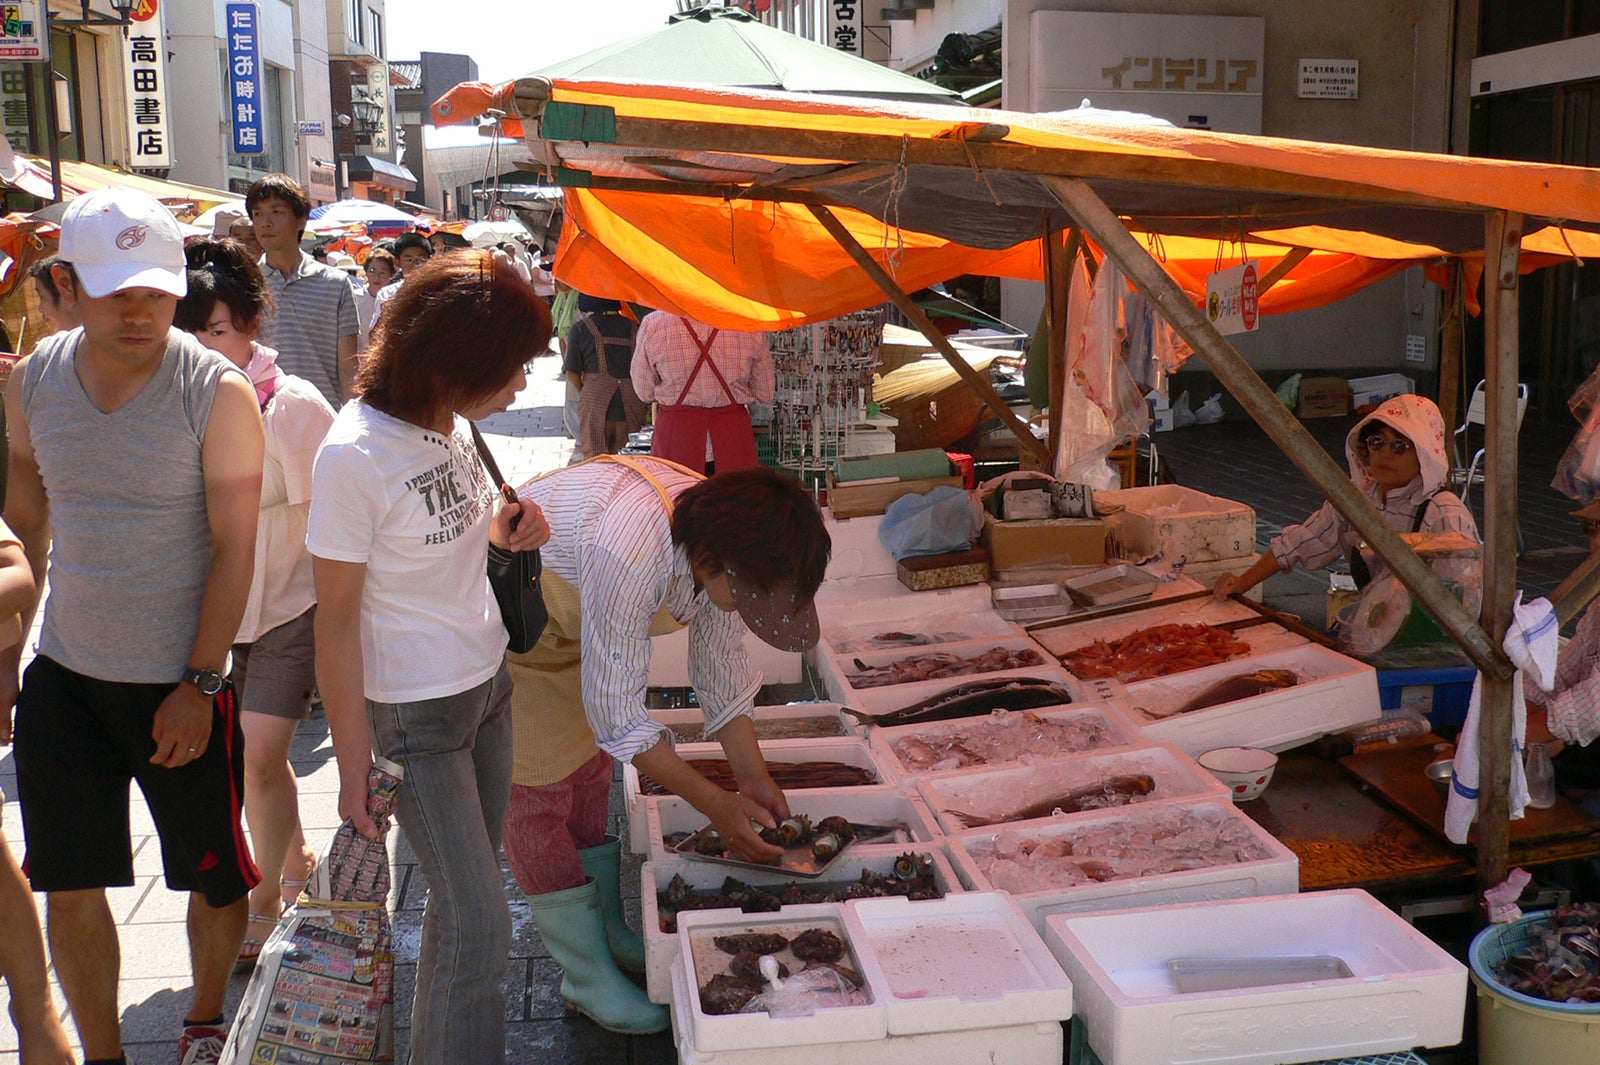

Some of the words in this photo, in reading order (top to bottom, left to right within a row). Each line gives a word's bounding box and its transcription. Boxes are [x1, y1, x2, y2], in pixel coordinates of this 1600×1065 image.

[232, 10, 257, 146] たたみ時計店
[1102, 56, 1257, 90] インテリア
[130, 35, 162, 156] 高田書店
[411, 469, 435, 488] PRAY
[418, 470, 467, 516] THE
[425, 522, 465, 545] FEELING
[465, 513, 473, 528] TO
[471, 502, 484, 521] THE
[1233, 540, 1240, 551] 3
